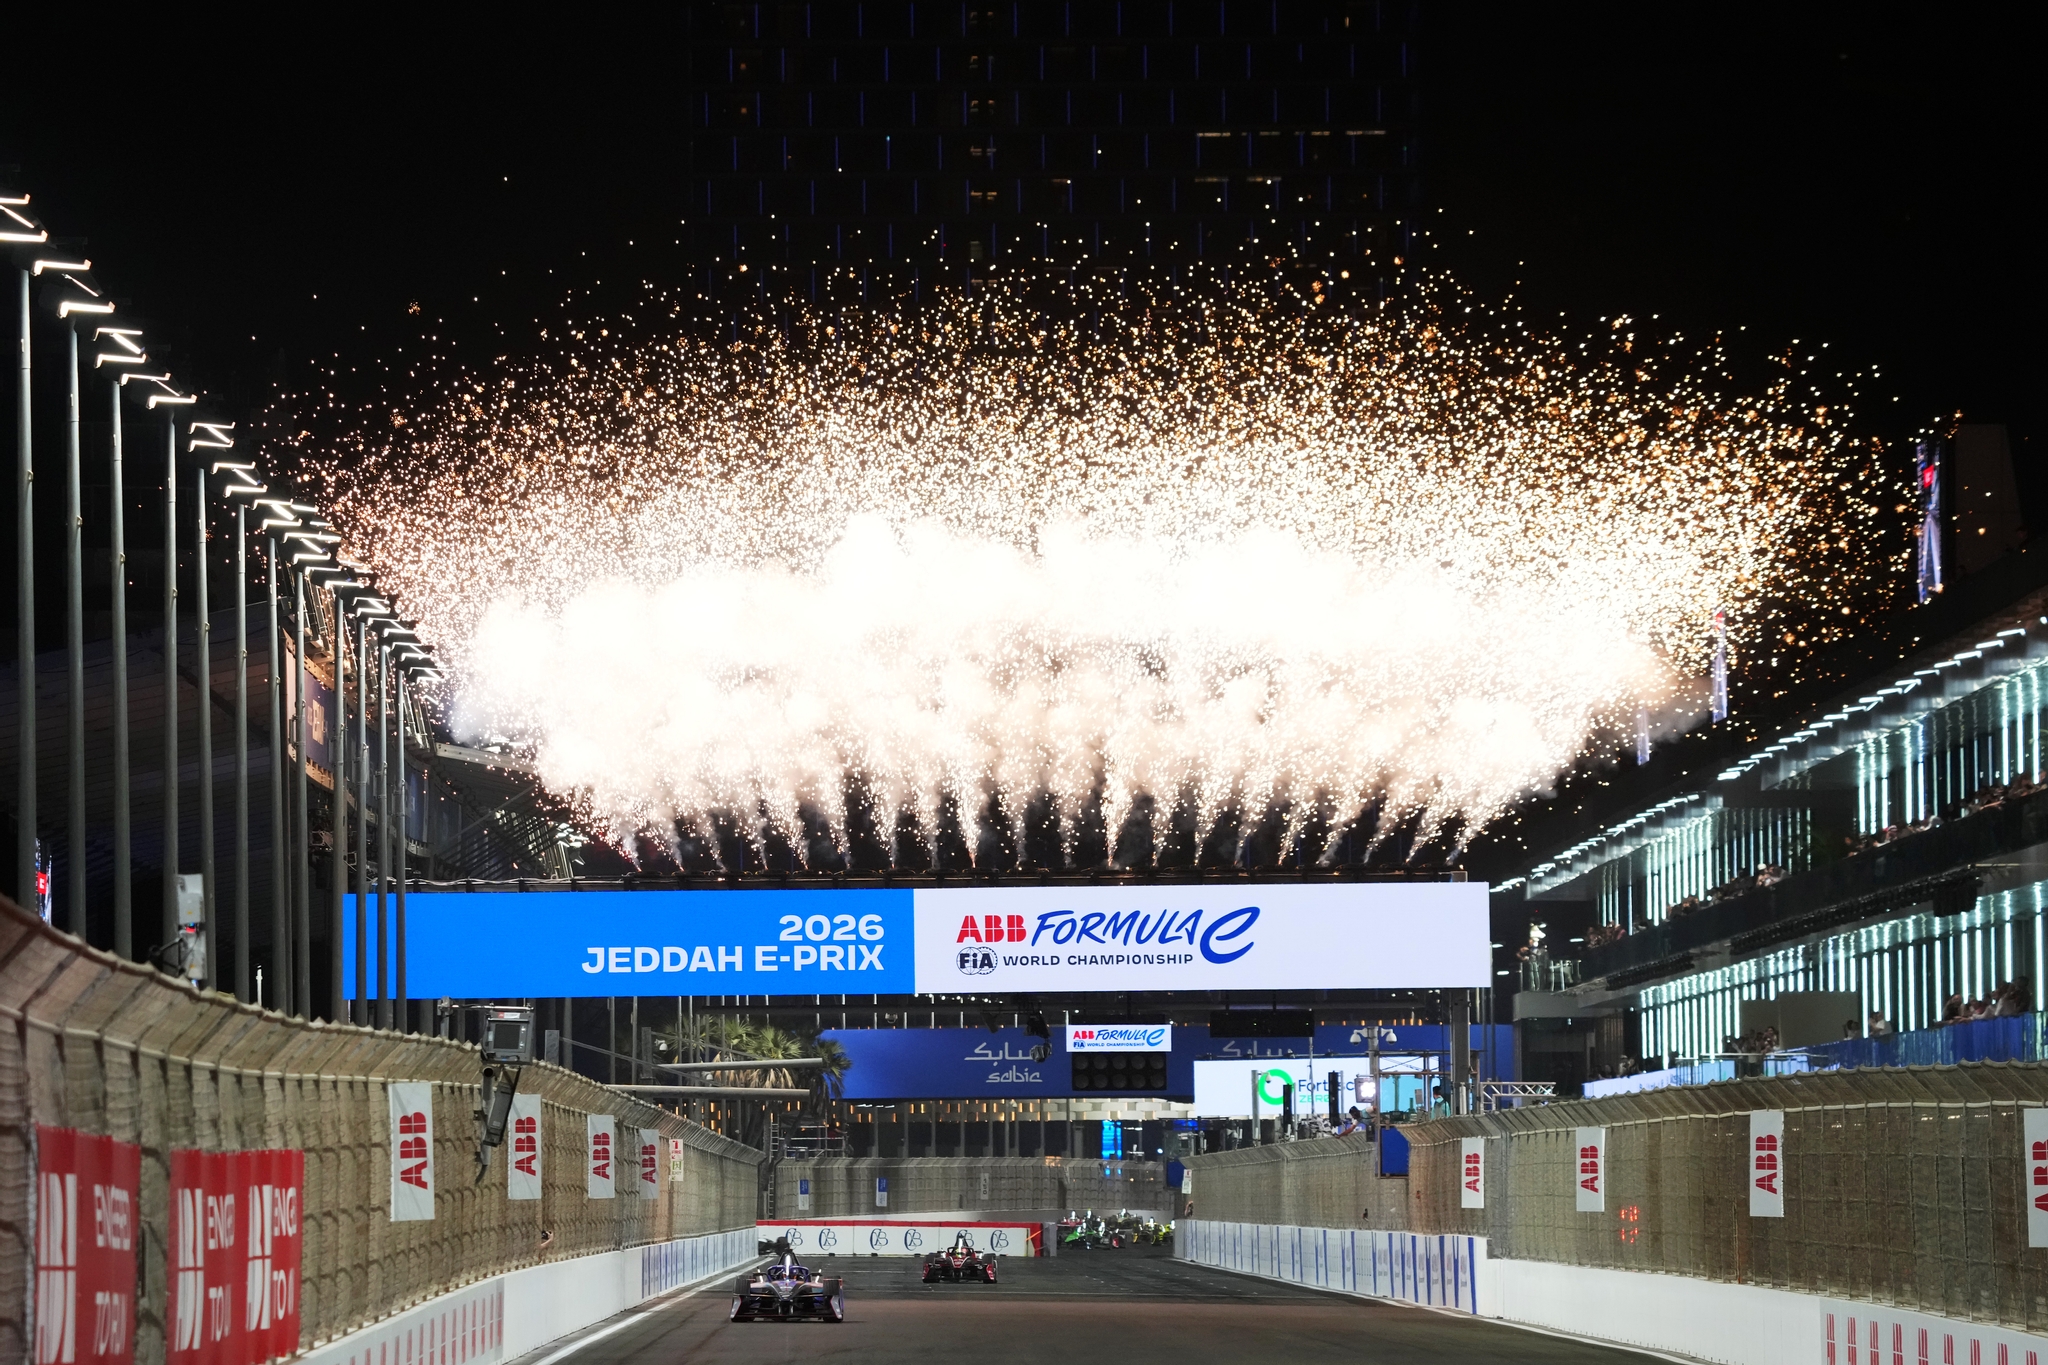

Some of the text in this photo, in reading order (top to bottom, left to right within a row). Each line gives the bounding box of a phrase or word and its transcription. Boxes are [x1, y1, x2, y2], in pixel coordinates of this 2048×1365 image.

[779, 914, 885, 941] 2026
[956, 914, 1027, 943] ABB
[1031, 908, 1203, 947] FORMULA
[581, 944, 885, 974] JEDDAH E-PRIX
[1003, 955, 1060, 966] WORLD
[1067, 953, 1193, 966] CHAMPIONSHIP
[1073, 1030, 1094, 1040] ABB
[1095, 1029, 1148, 1041] FORMULA
[400, 1112, 428, 1190] ABB
[515, 1116, 537, 1176] ABB
[593, 1132, 610, 1179] ABB
[641, 1144, 656, 1183] ABB
[1755, 1134, 1778, 1194] ABB
[1465, 1152, 1480, 1193] ABB
[1580, 1145, 1598, 1193] ABB
